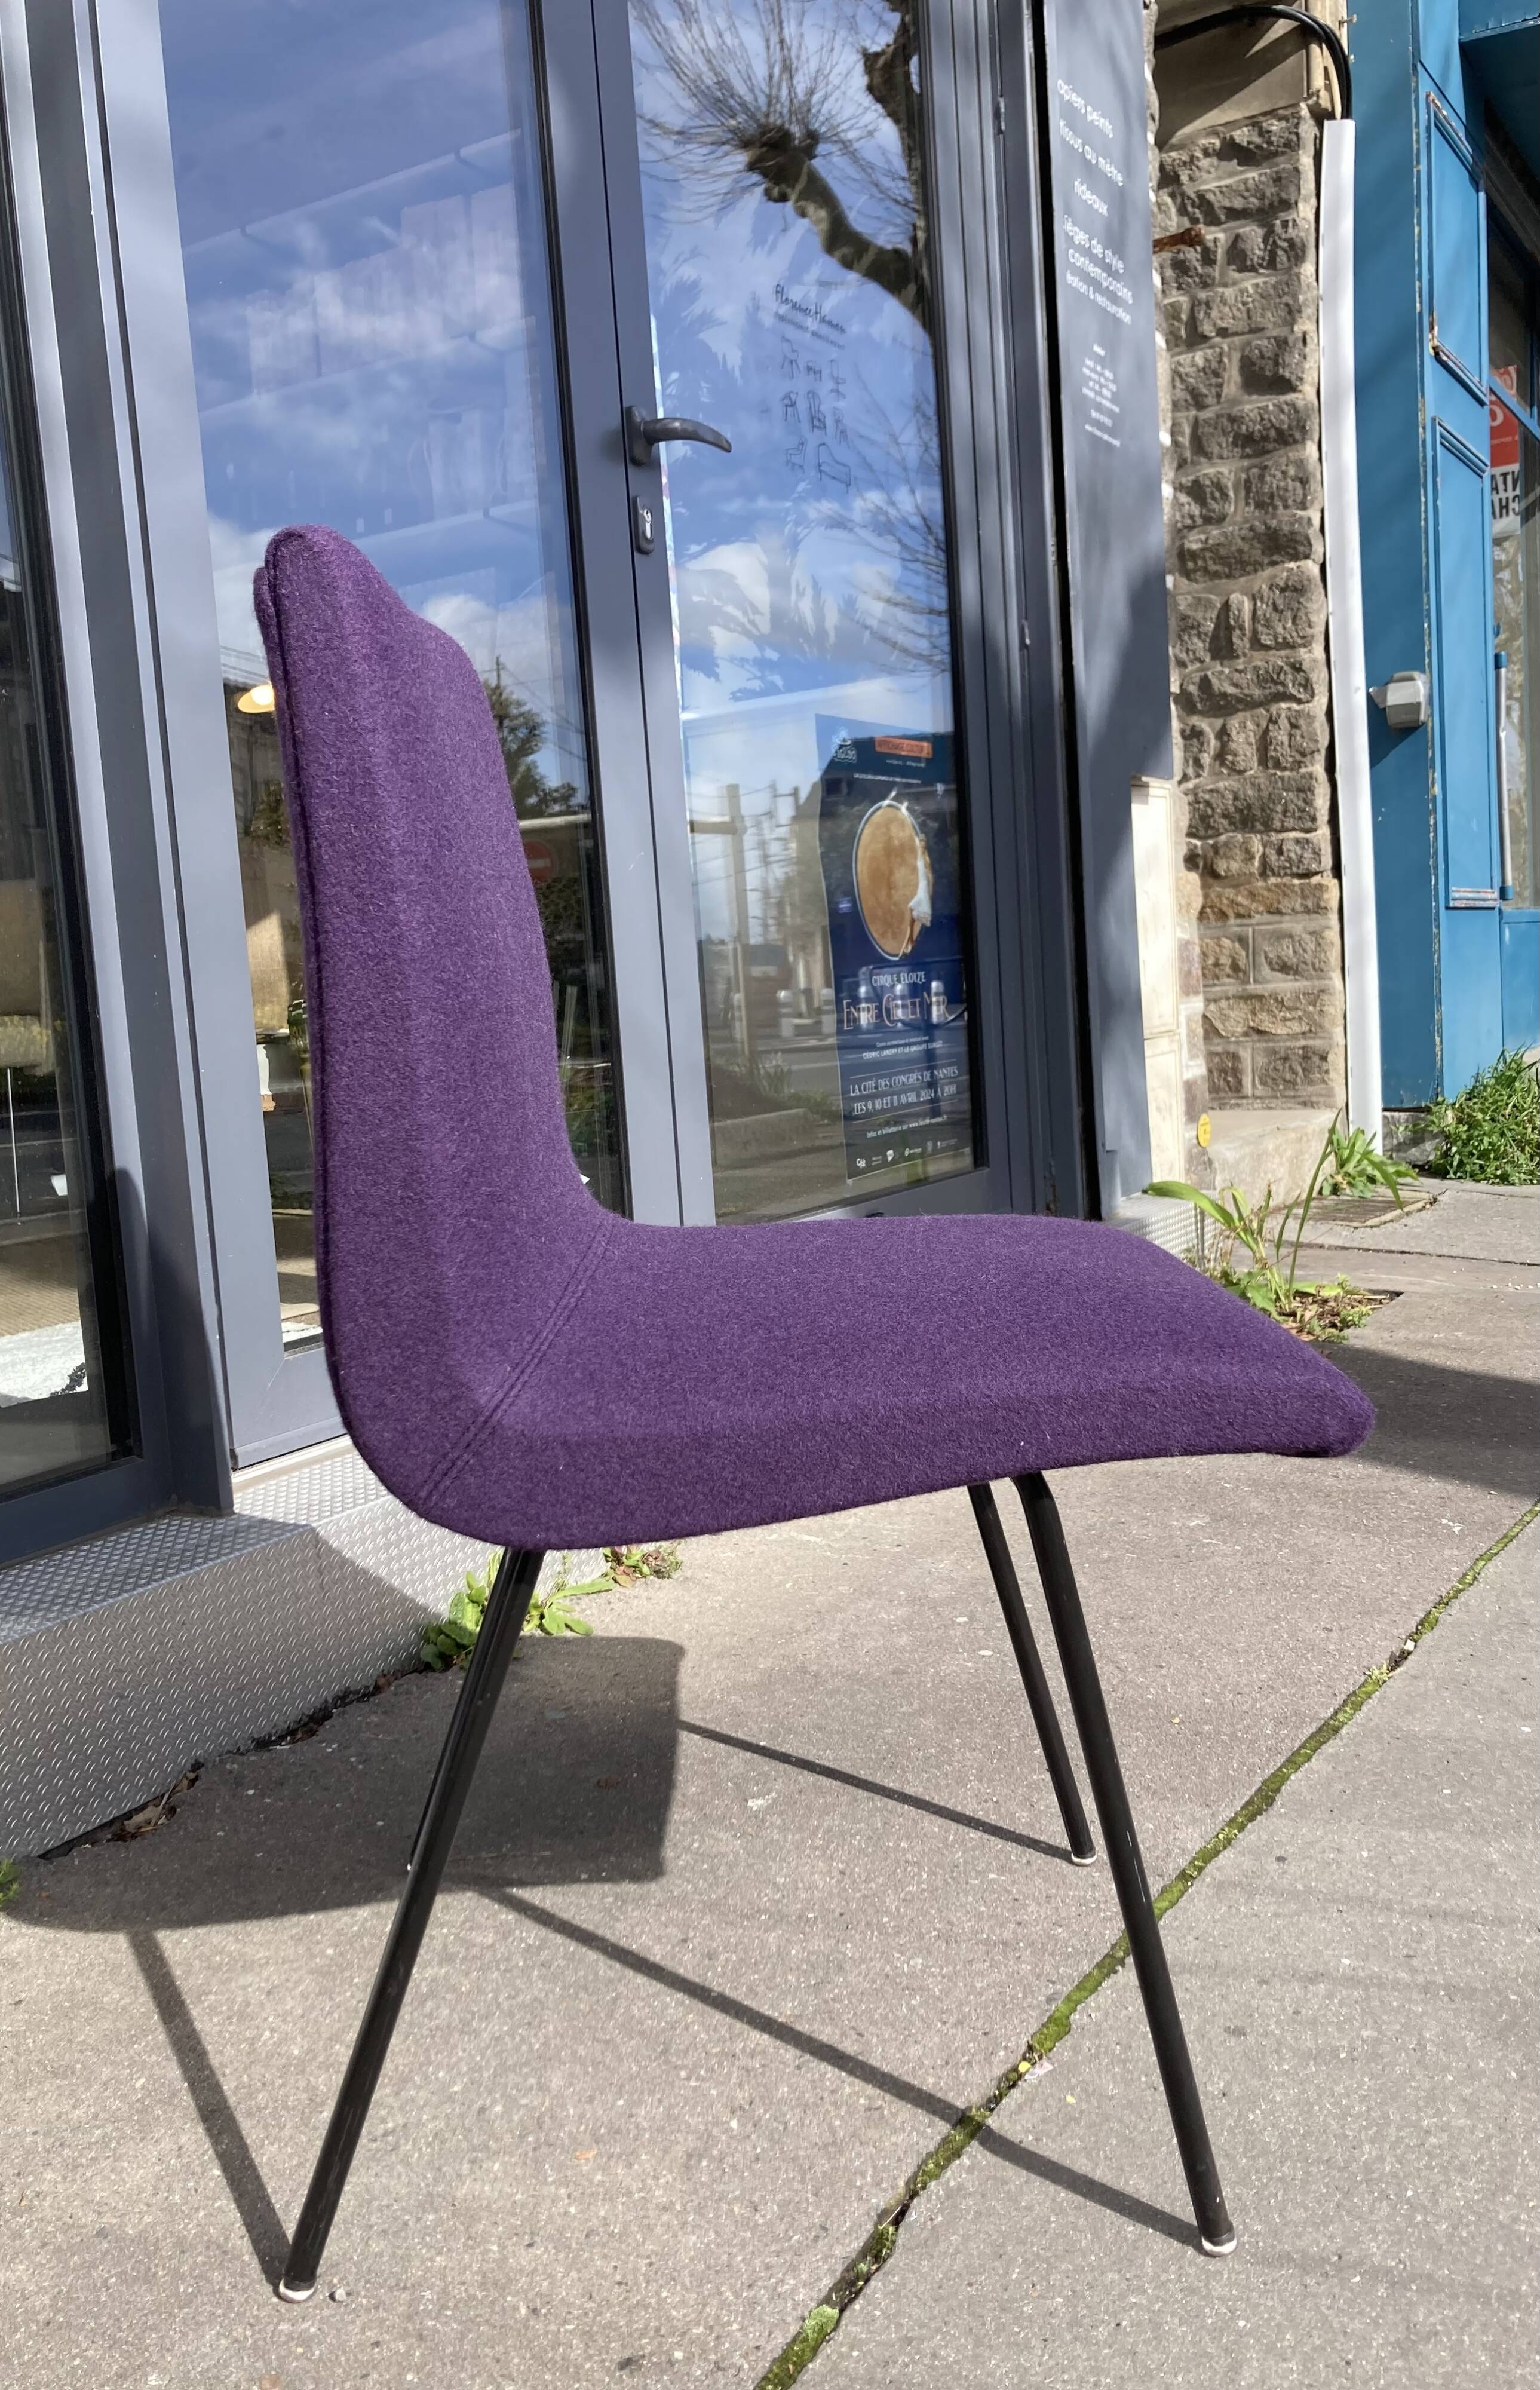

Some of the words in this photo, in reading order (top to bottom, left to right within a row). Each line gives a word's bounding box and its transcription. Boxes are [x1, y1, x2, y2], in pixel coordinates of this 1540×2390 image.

[1057, 79, 1085, 114] apiers
[1087, 106, 1113, 138] peints
[1084, 145, 1097, 164] au
[1098, 157, 1123, 186] mètre
[1075, 178, 1108, 217] rideaux
[1063, 215, 1089, 248] ièges
[1091, 238, 1103, 258] de
[1105, 249, 1124, 274] style
[1068, 249, 1133, 304] contemporains
[872, 974, 897, 986] CIRQUE
[850, 1084, 859, 1096] LA
[861, 1077, 876, 1093] CITÉ
[878, 1078, 889, 1090] DES
[892, 1070, 922, 1087] CONGRÈS
[923, 1070, 932, 1081] DE
[934, 1066, 958, 1079] NANTES
[854, 1102, 866, 1114] LES
[875, 1098, 882, 1110] 10
[883, 1096, 891, 1108] ET
[900, 1092, 918, 1104] AVRIL
[920, 1088, 934, 1101] 2024
